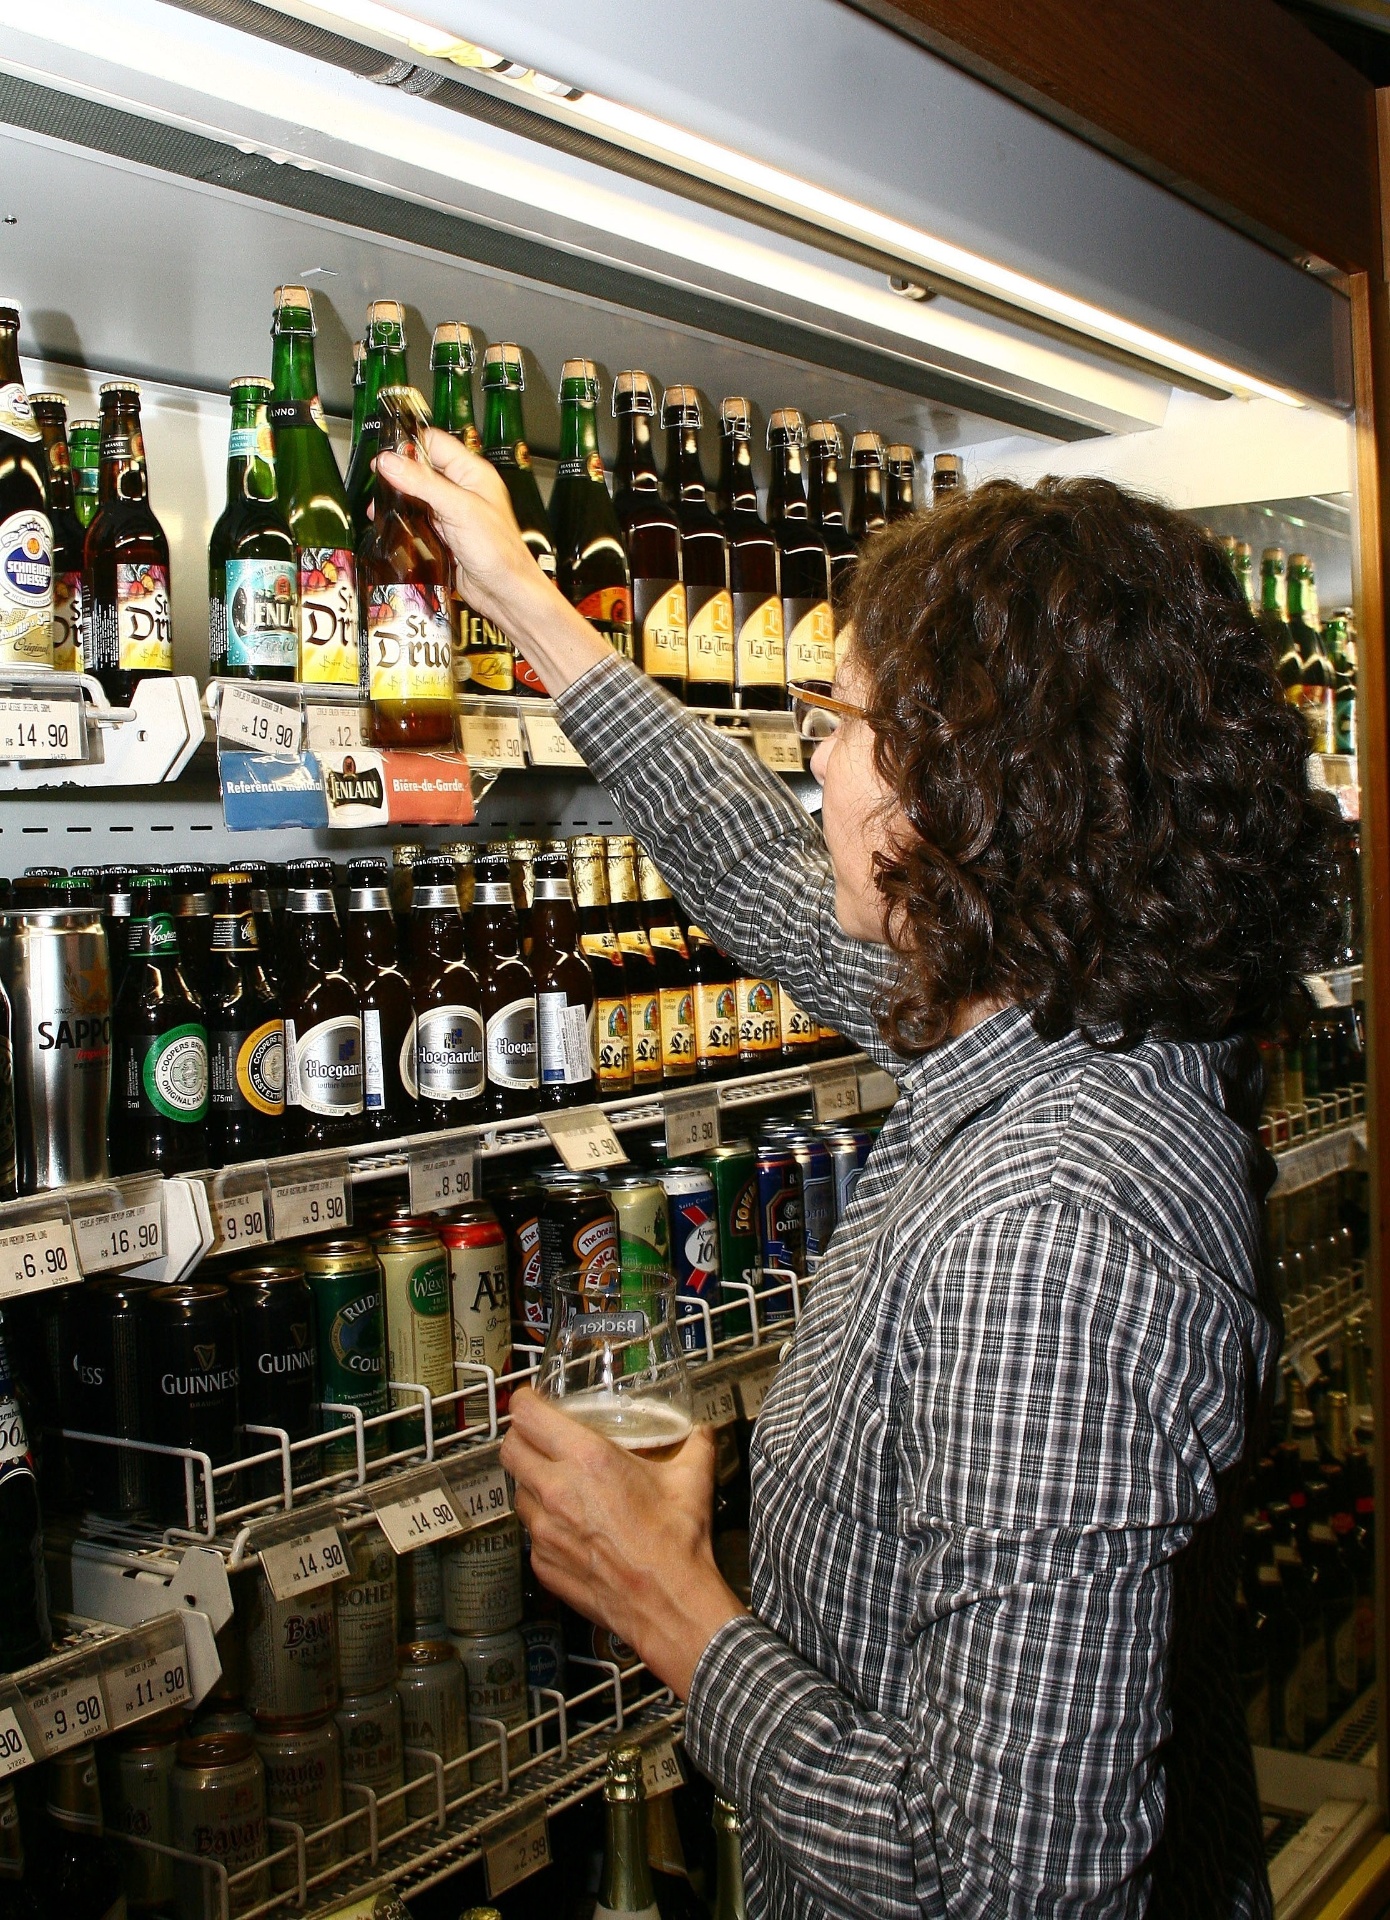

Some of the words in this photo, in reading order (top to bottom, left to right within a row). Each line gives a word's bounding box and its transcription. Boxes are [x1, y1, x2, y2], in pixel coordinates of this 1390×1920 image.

[16, 573, 49, 587] WEISSE
[155, 594, 168, 615] St
[236, 600, 298, 632] JENLA
[406, 615, 427, 638] St
[14, 638, 49, 651] Original
[18, 723, 68, 748] 14,90
[251, 715, 293, 748] 19,90
[329, 776, 379, 807] JENLAIN
[161, 1042, 189, 1072] COOPERS
[253, 1035, 278, 1064] COOPERS
[162, 1080, 191, 1105] ORIGINAL
[253, 1075, 271, 1094] BEST
[212, 1095, 233, 1103] 375ml
[690, 1121, 713, 1142] 8,90
[590, 1137, 618, 1156] 8,90
[443, 1172, 470, 1196] 8,90
[310, 1197, 344, 1222] 9,90
[227, 1211, 263, 1240] 9,90
[582, 1233, 597, 1248] The
[597, 1228, 609, 1240] One
[111, 1223, 158, 1256] 16,90
[23, 1247, 68, 1278] 6,90
[161, 1368, 240, 1395] GUINNESS
[470, 1487, 504, 1518] 14,90
[412, 1504, 455, 1533] 14,90
[299, 1544, 343, 1578] 14,90
[136, 1666, 184, 1707] 11,90
[54, 1695, 101, 1735] 9,90
